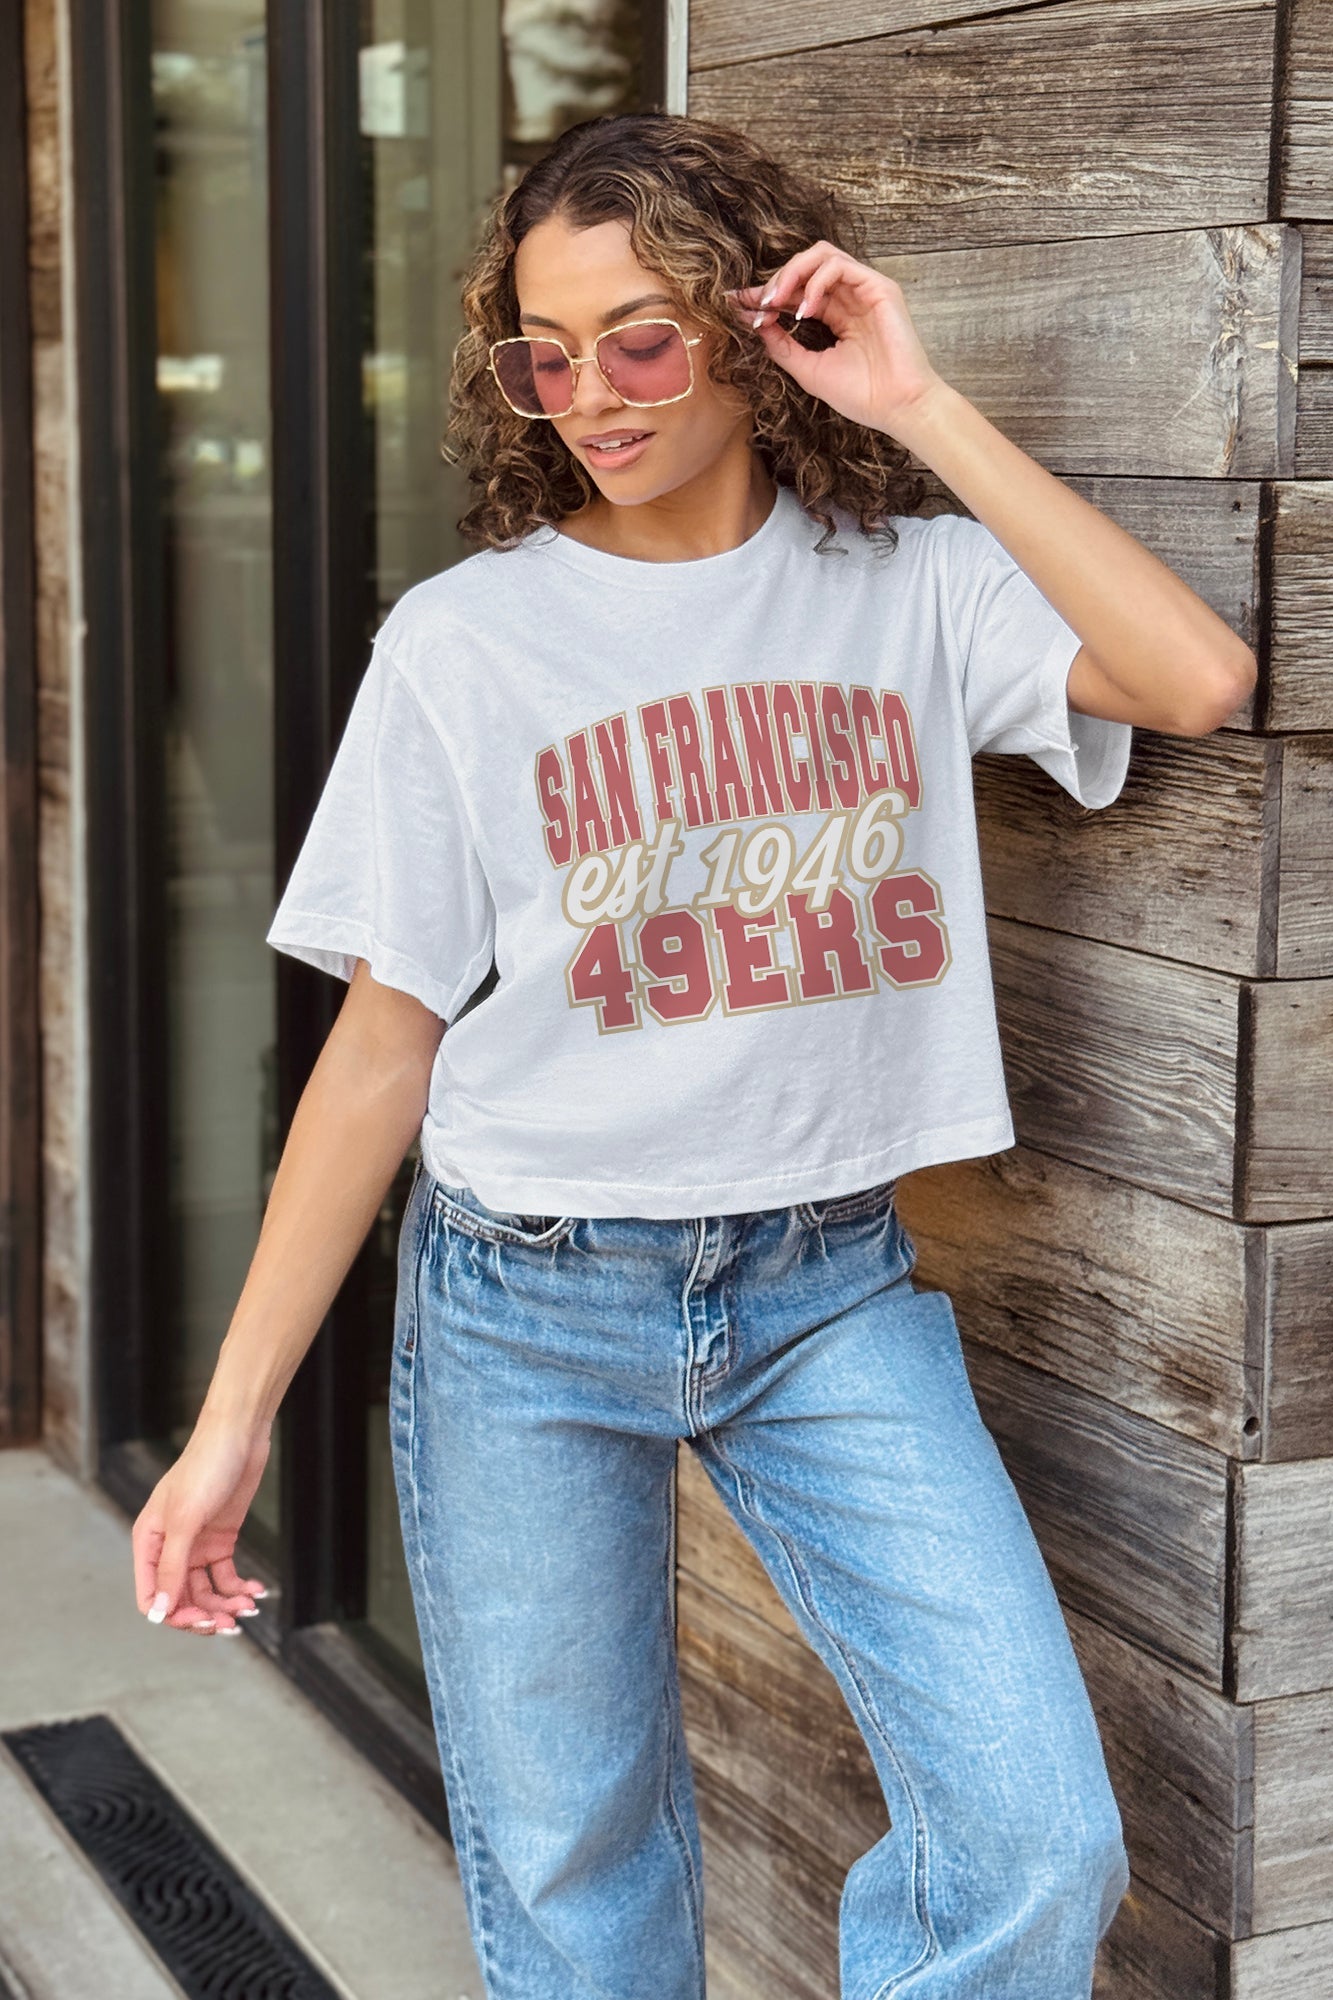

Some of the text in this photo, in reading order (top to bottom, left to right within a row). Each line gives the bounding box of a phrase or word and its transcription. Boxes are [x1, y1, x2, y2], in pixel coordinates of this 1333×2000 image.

[535, 681, 924, 869] SAN FRANCISCO
[562, 787, 909, 928] est 1946
[564, 867, 953, 1036] 49ERS
